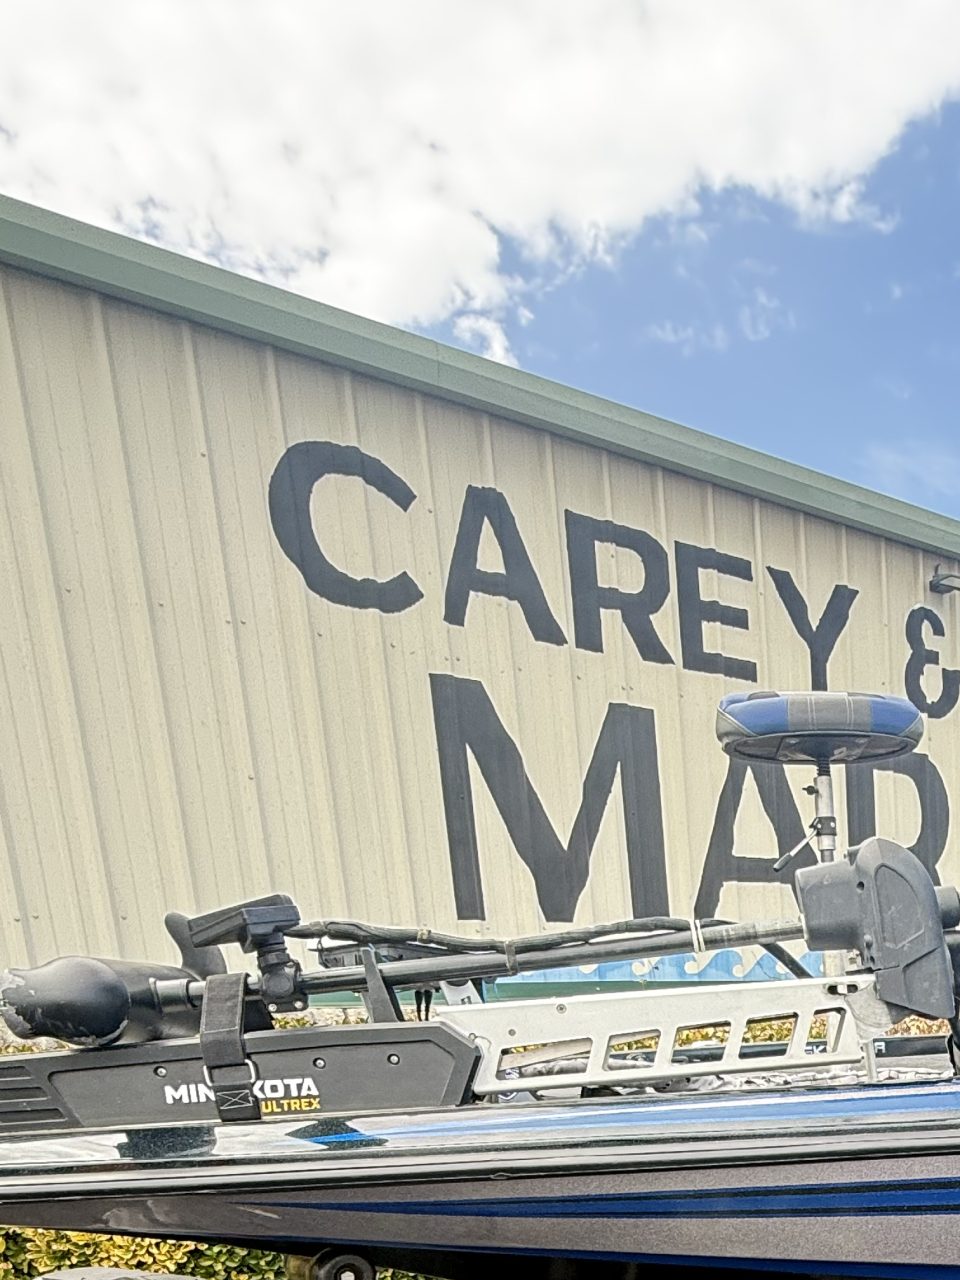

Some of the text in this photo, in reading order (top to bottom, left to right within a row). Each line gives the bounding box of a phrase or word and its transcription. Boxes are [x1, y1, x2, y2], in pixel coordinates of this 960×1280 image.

[268, 440, 860, 691] CAREY
[163, 1083, 217, 1105] MIN
[260, 1097, 321, 1114] ULTREX
